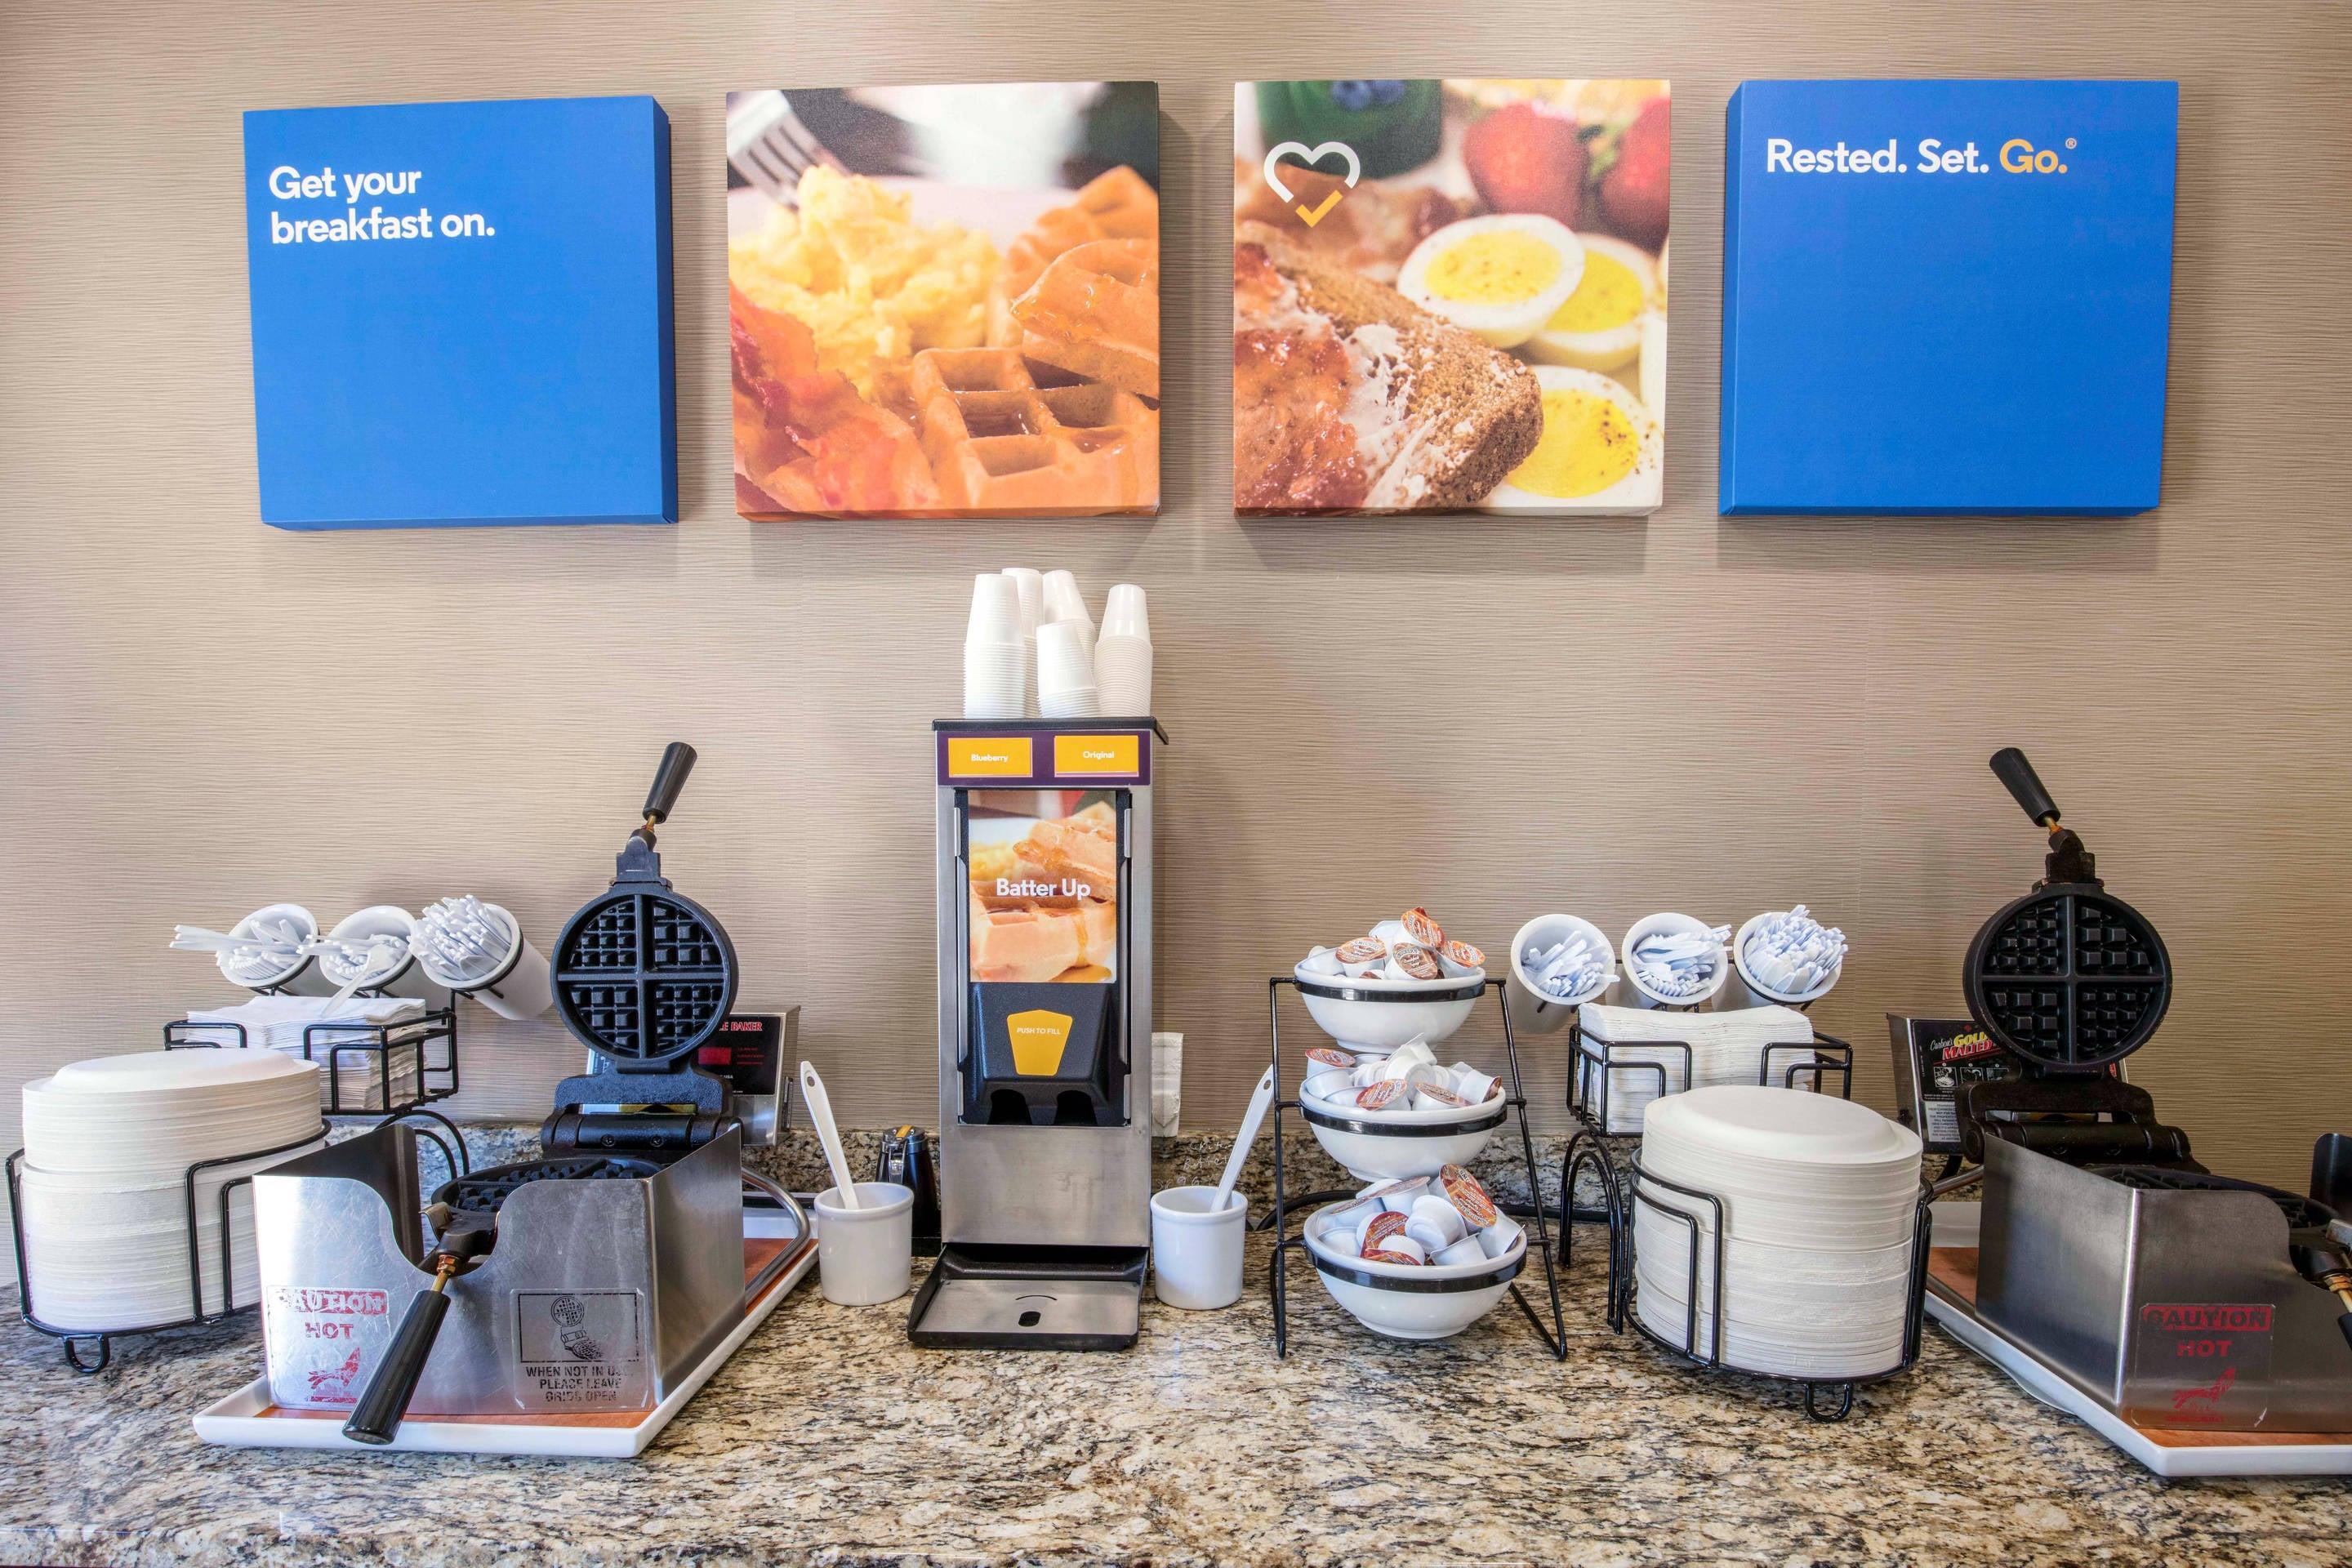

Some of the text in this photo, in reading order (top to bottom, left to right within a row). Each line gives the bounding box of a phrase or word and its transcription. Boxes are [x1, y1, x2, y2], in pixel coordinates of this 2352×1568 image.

[1766, 138, 1908, 174] Rested.
[1917, 138, 1989, 174] Set.
[269, 166, 421, 204] Get your
[270, 207, 496, 244] breakfast on.
[970, 753, 1009, 763] Blueberry
[1082, 751, 1115, 760] Original
[996, 878, 1091, 901] Batter Up
[731, 1022, 763, 1031] BAKER
[1035, 1027, 1046, 1035] TO
[1047, 1027, 1062, 1036] FILL
[1942, 1039, 1994, 1061] MALTED
[280, 1292, 385, 1312] AUTION
[2145, 1309, 2266, 1328] CAUTION
[305, 1321, 354, 1340] HOT
[2176, 1339, 2233, 1357] HOT
[525, 1365, 561, 1377] WHEN
[564, 1365, 589, 1377] NOT
[592, 1365, 604, 1376] IN
